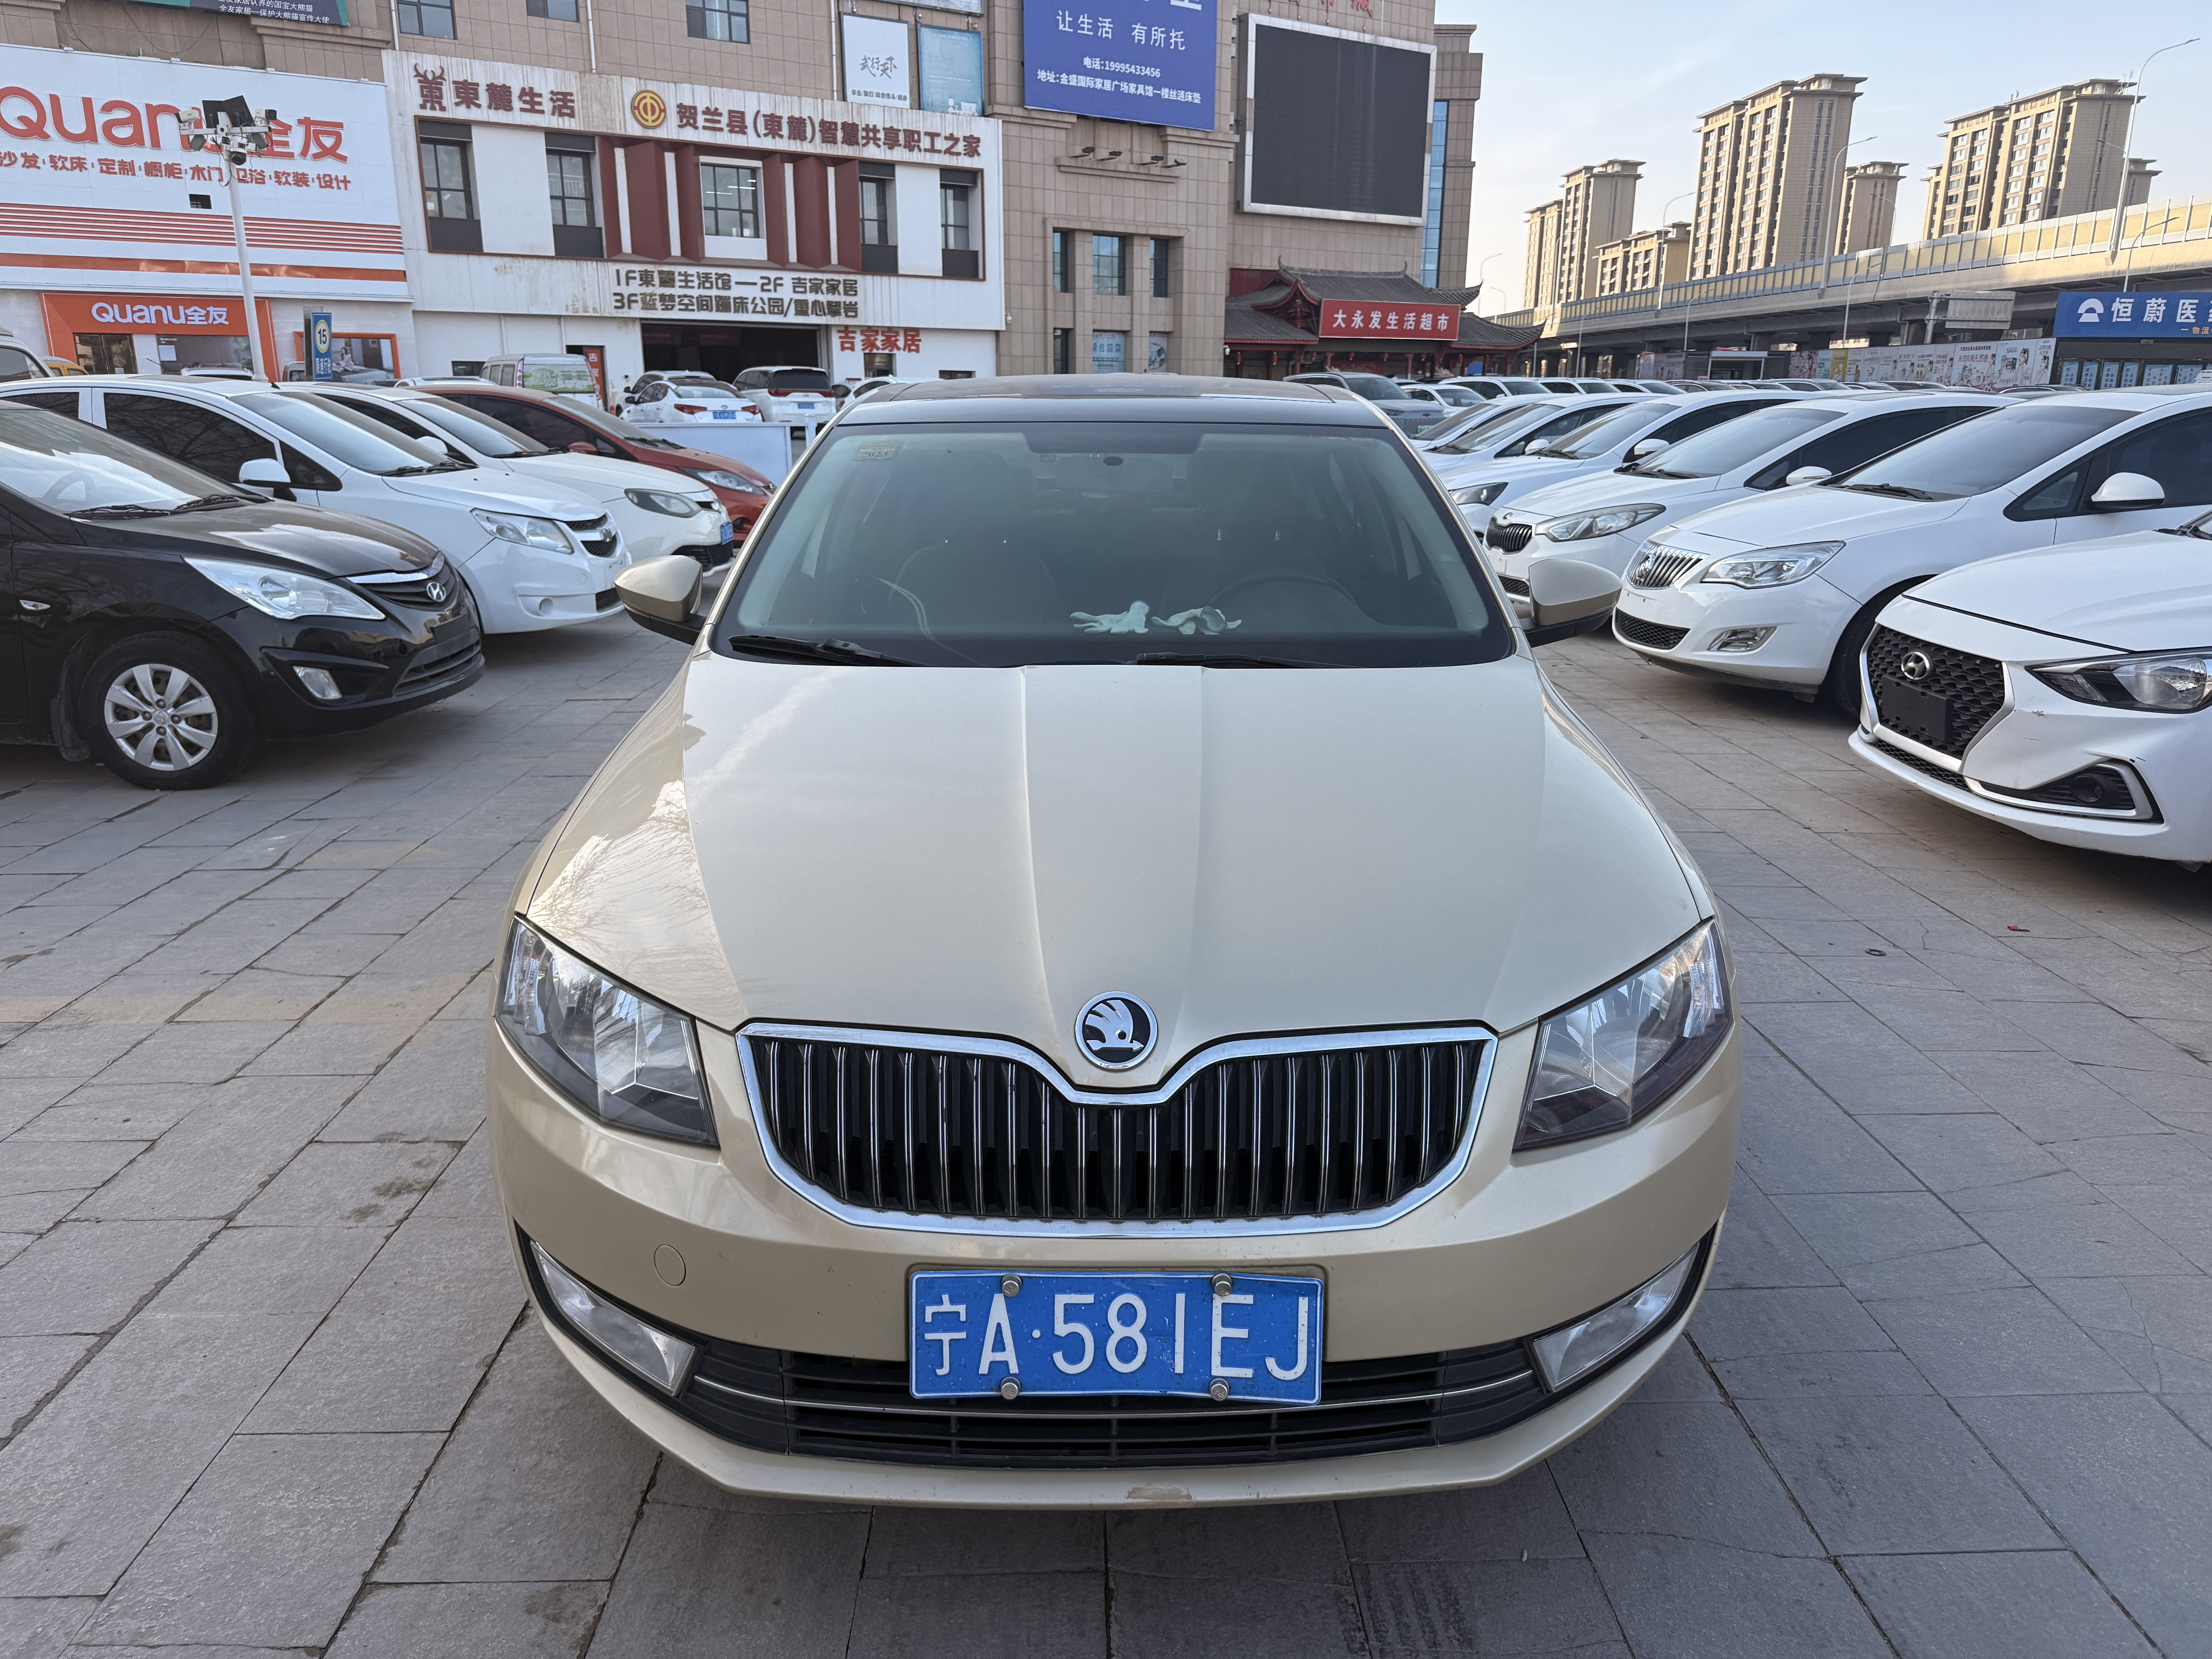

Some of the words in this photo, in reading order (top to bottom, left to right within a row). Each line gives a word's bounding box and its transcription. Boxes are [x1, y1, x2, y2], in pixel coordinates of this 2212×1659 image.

[218, 0, 313, 12] 友家居认养的国宝大熊猫
[1056, 10, 1113, 39] 让生活
[1132, 22, 1185, 50] 有所托
[0, 86, 348, 163] Quan全友
[791, 276, 858, 296] 吉家家居
[1333, 309, 1449, 331] 大永发生活超市
[318, 329, 327, 345] 15
[837, 326, 922, 354] 吉家家居
[924, 1293, 1309, 1381] 宁A·581EJ
